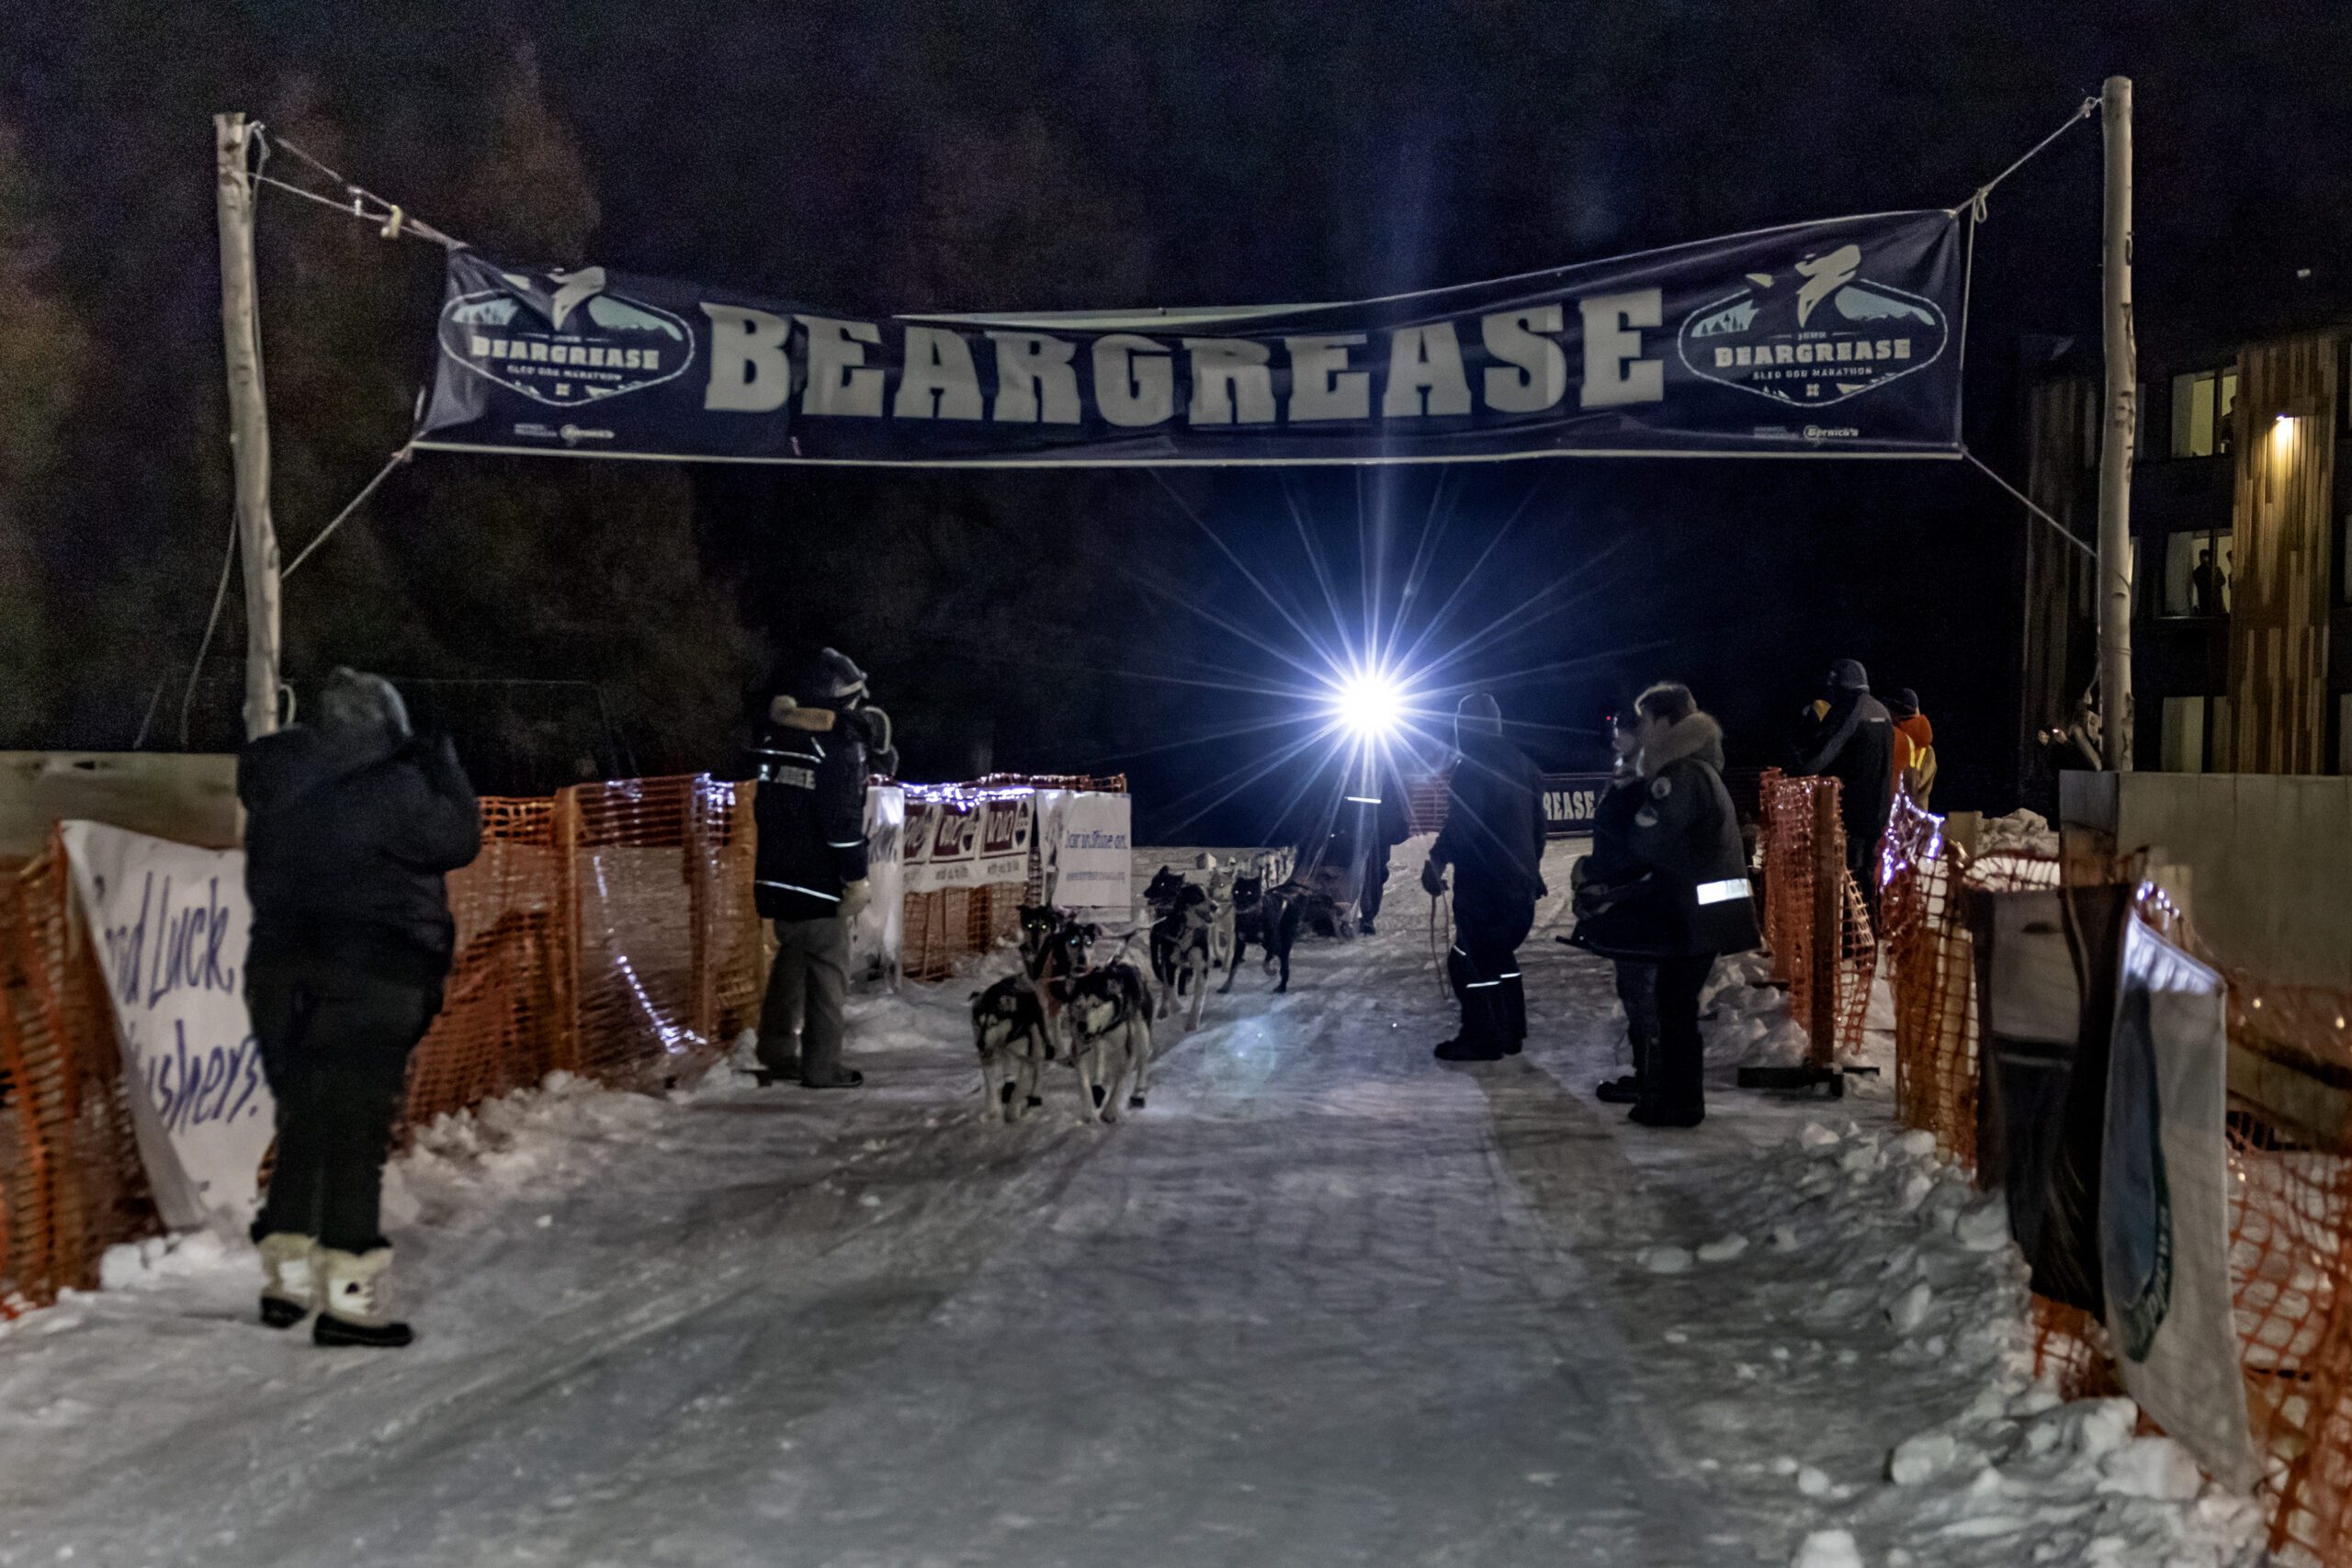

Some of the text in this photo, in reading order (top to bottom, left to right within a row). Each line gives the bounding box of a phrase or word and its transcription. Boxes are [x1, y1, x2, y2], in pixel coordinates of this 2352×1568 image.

[471, 334, 660, 370] BEARGREASE
[700, 288, 1664, 427] BEARGREASE
[1714, 338, 1911, 367] BEARGREASE
[148, 874, 235, 1011] Luck
